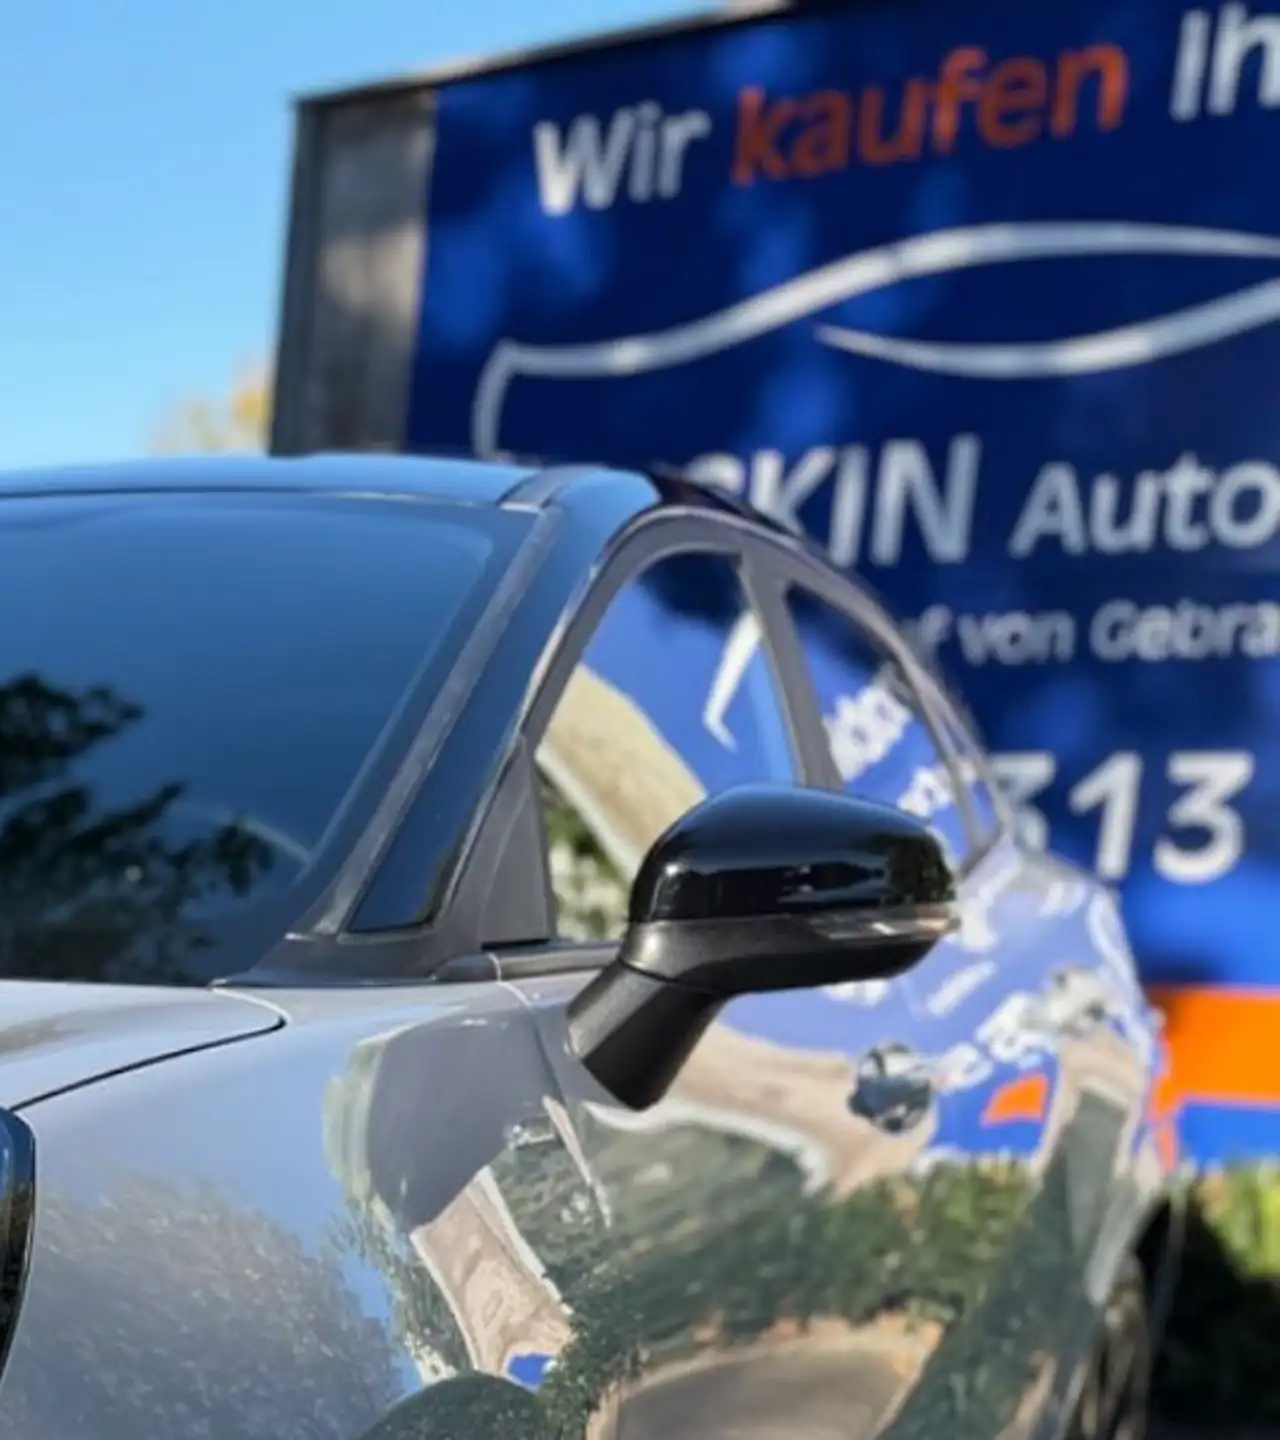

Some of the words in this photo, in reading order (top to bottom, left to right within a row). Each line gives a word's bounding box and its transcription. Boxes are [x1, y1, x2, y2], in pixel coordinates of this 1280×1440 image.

[532, 101, 712, 217] Wir
[728, 43, 1130, 187] kaufen
[1168, 1, 1280, 122] Ih
[1007, 450, 1280, 560] Auto
[957, 610, 1075, 664] von
[1089, 598, 1280, 664] Gebra
